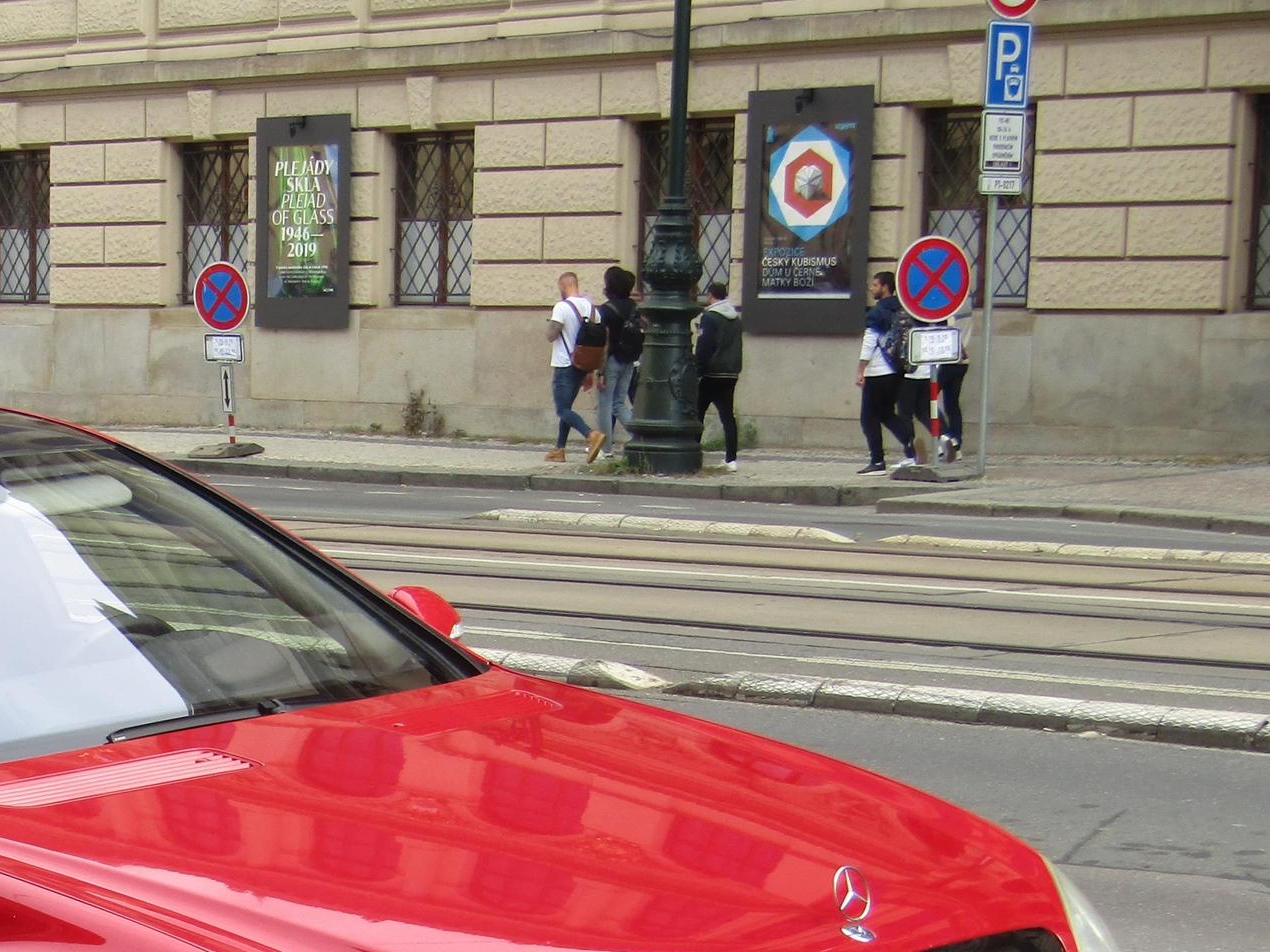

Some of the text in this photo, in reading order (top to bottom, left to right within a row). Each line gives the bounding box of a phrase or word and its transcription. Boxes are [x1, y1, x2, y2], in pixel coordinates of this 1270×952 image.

[996, 32, 1022, 80] P
[275, 156, 334, 176] PLEJÁDY
[287, 177, 321, 193] SKLA
[272, 209, 334, 225] OF GLASS
[287, 242, 317, 257] 2019
[763, 247, 805, 256] EXPOZICE
[762, 256, 837, 267] ČESKÝ KUBISMUS
[785, 268, 790, 276] U
[762, 278, 791, 287] MATKY
